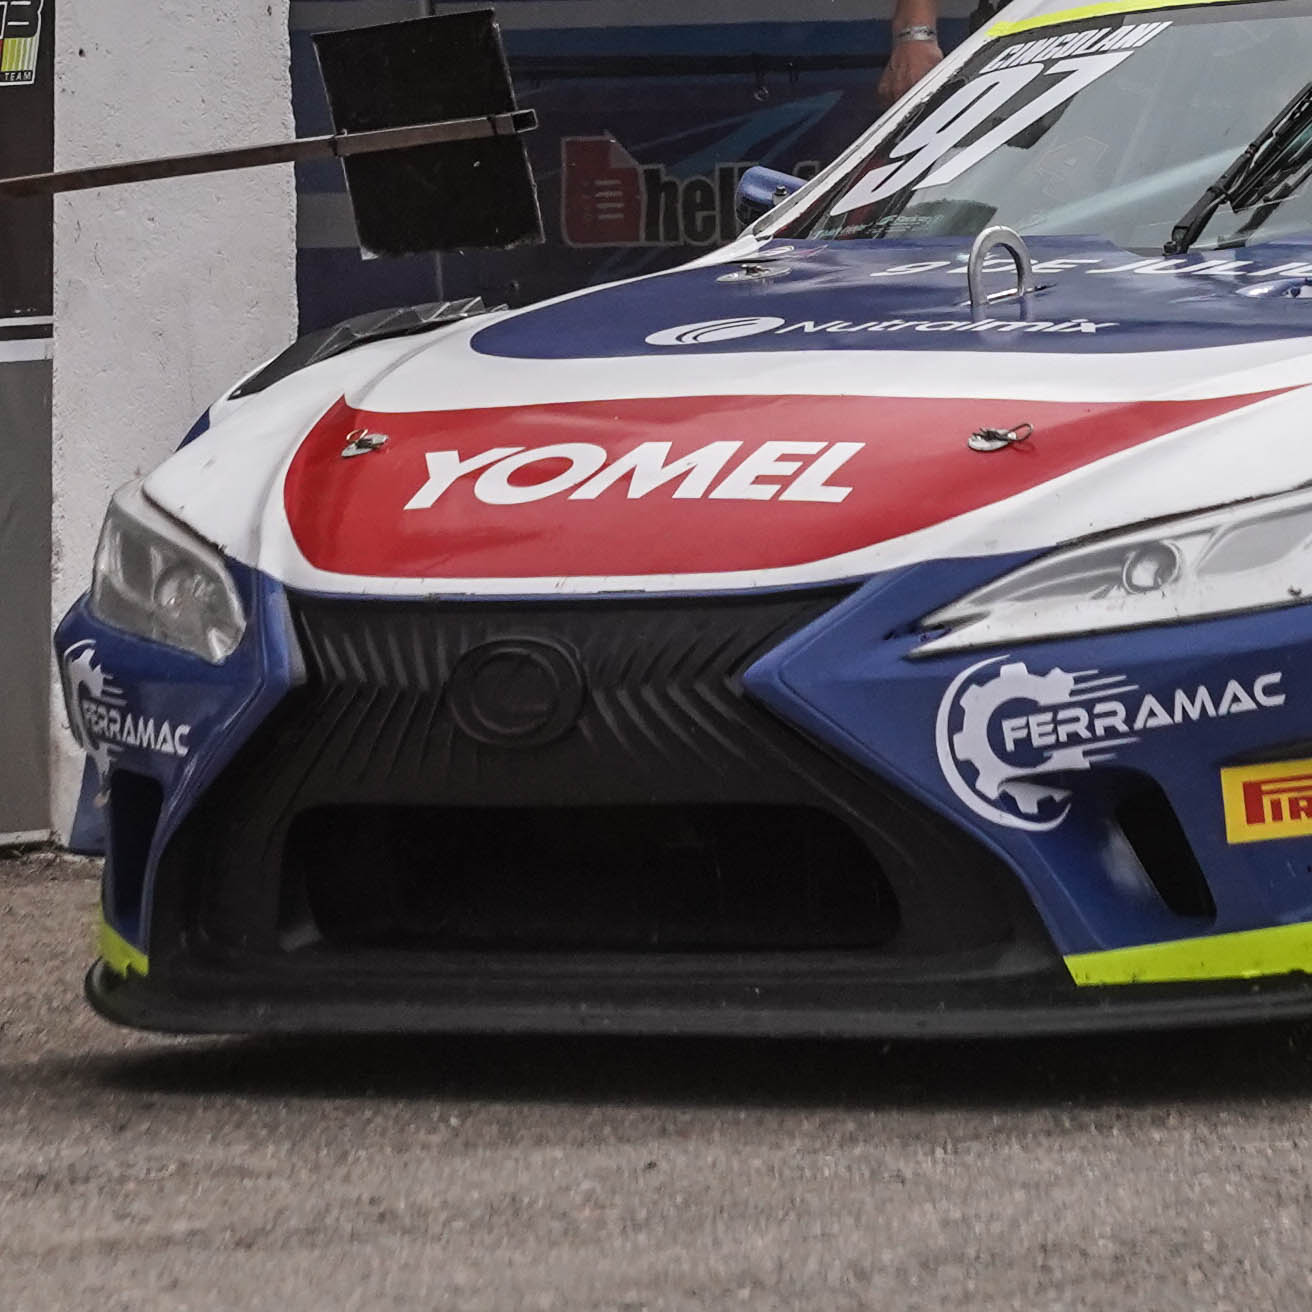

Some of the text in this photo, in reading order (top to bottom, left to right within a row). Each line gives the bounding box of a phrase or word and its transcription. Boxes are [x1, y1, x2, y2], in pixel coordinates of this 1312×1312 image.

[4, 70, 33, 82] TEAM
[978, 20, 1174, 74] CINGOLANI
[830, 49, 1135, 215] 97
[403, 440, 867, 510] YOMEL
[1002, 672, 1287, 754] FERRAMAC
